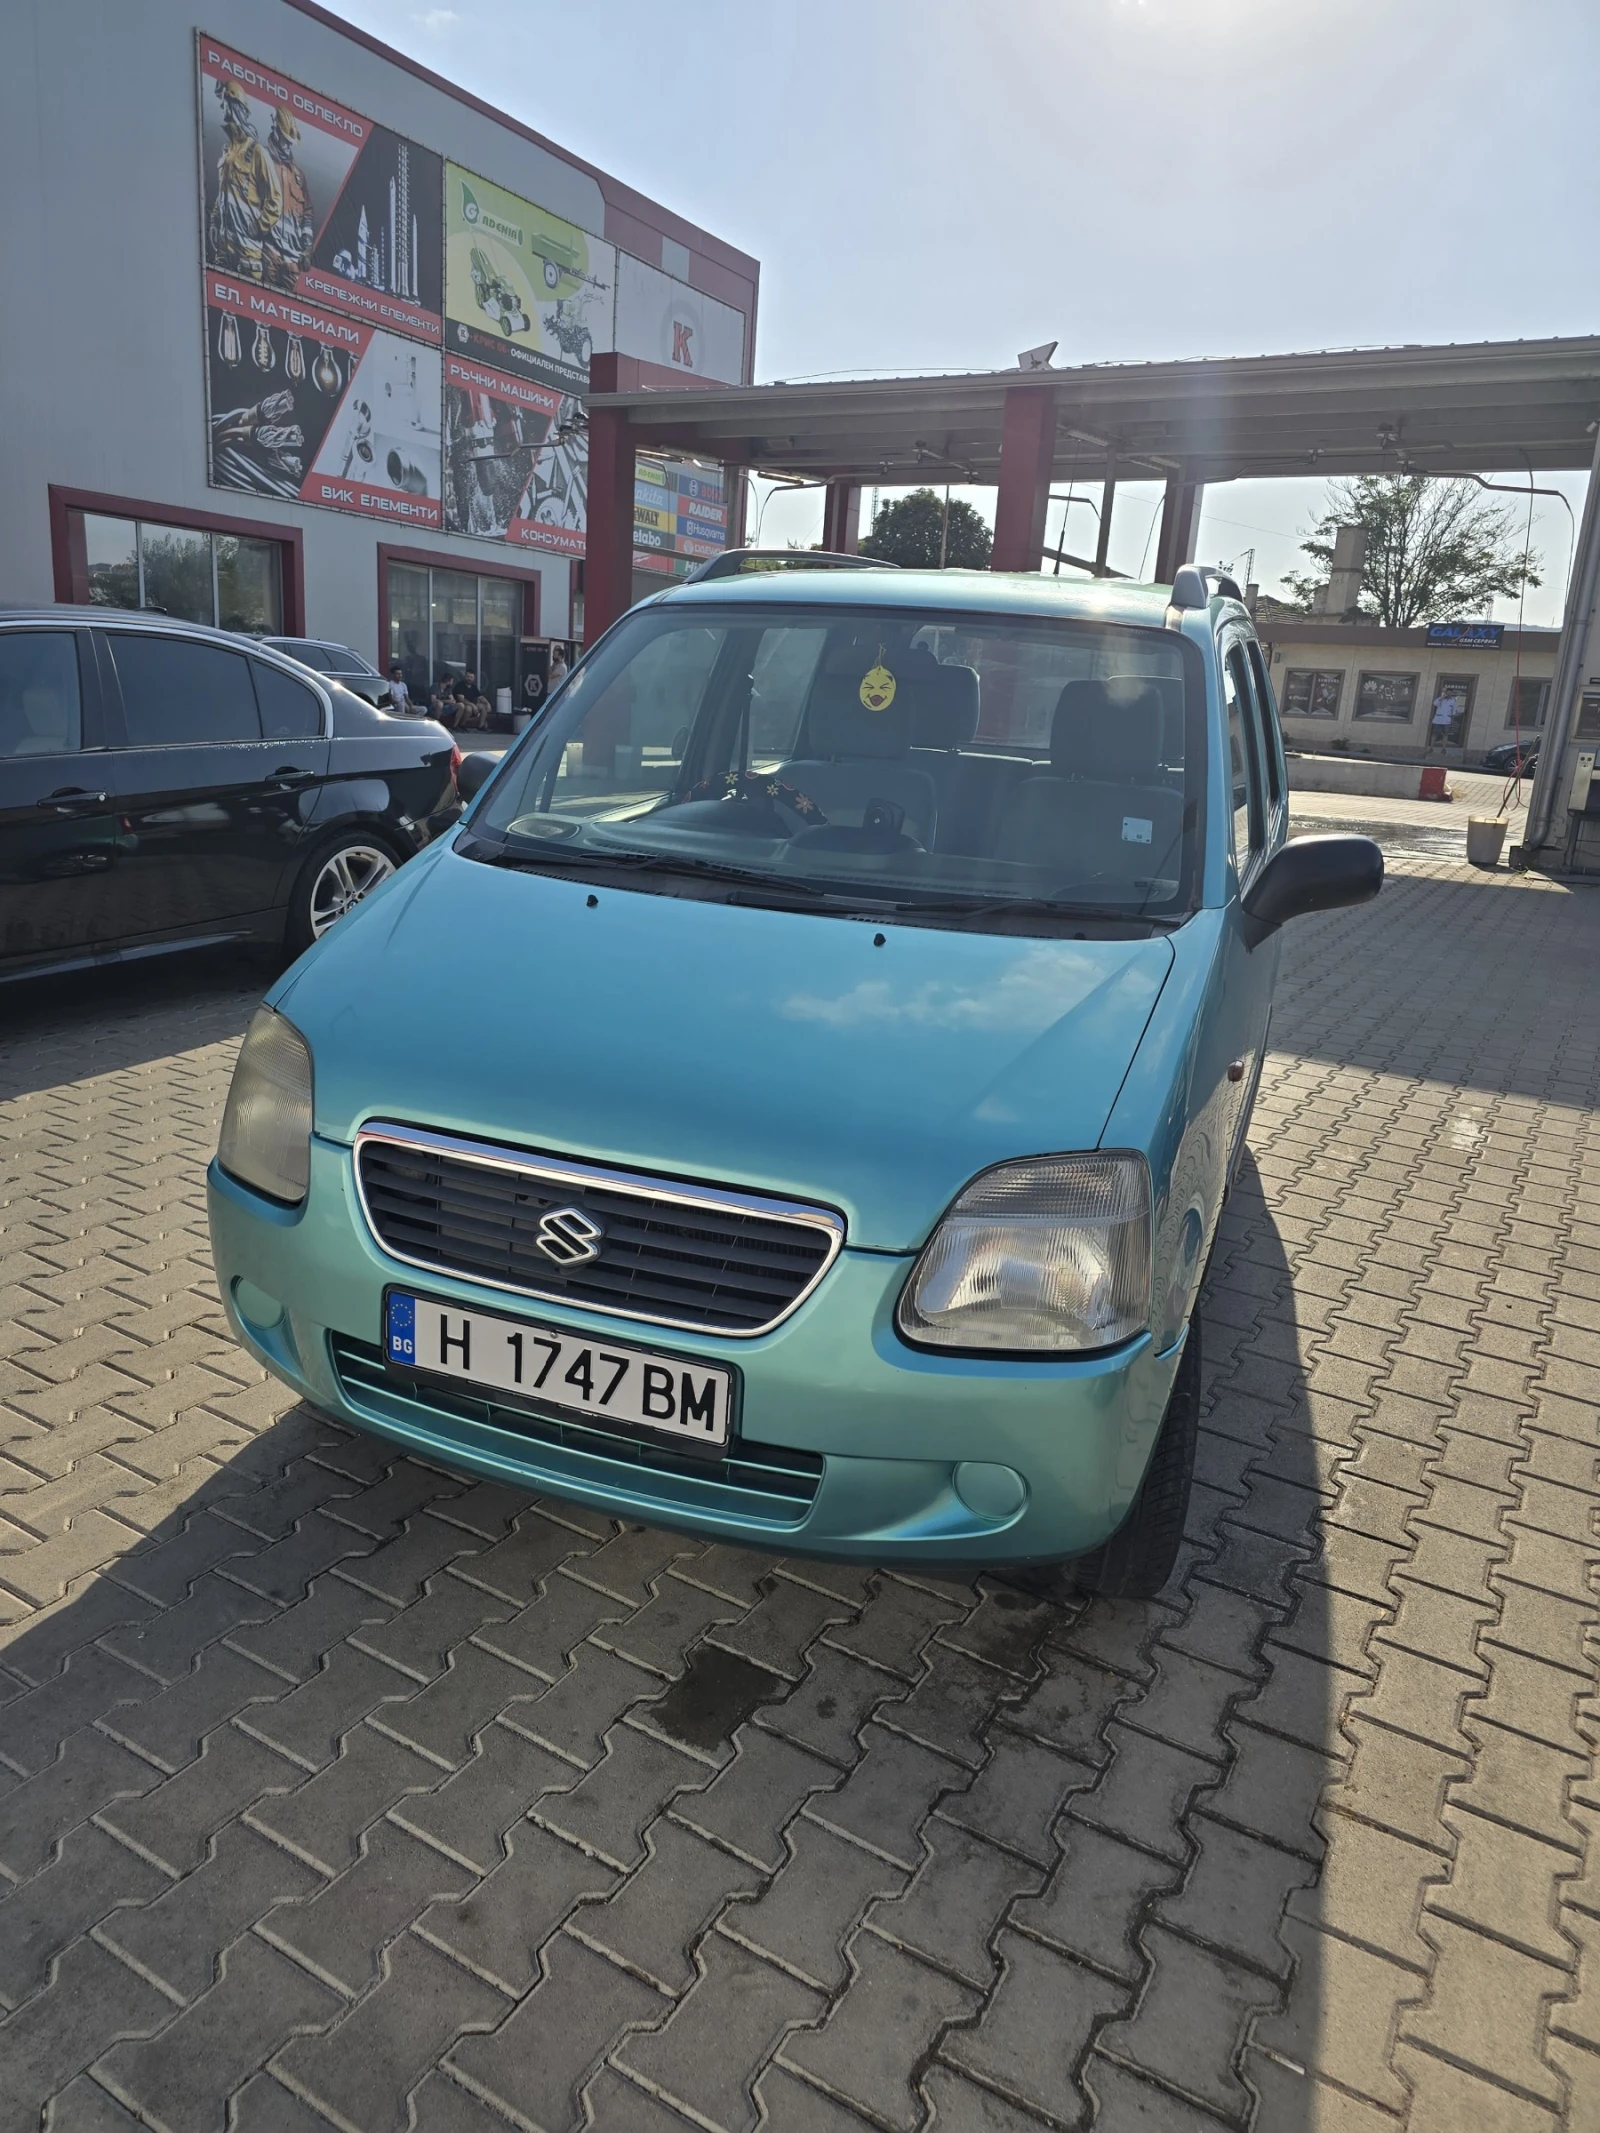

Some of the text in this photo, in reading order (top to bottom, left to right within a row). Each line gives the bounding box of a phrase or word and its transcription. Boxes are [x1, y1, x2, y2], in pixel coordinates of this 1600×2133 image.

[208, 51, 363, 138] РАБОТНО ОБЛЕКЛО
[215, 283, 360, 344] ЕЛ. МАТЕРИАЛИ
[305, 277, 440, 335] КРЕПЕЖНИ ЕЛЕМЕНТИ
[510, 348, 554, 370] ОФИЦИАЛЕН
[450, 364, 554, 408] РЪЧНИ МАШИНИ
[321, 485, 438, 520] ВИК ЕЛЕМЕНТИ
[635, 486, 663, 506] akita
[634, 507, 659, 526] EWALT
[689, 502, 722, 521] RAIDER
[634, 530, 660, 546] etabo
[694, 524, 725, 540] Husqvarna
[1430, 626, 1500, 639] GALAXY
[393, 1336, 413, 1354] BG
[440, 1313, 716, 1432] H 1747 BM
